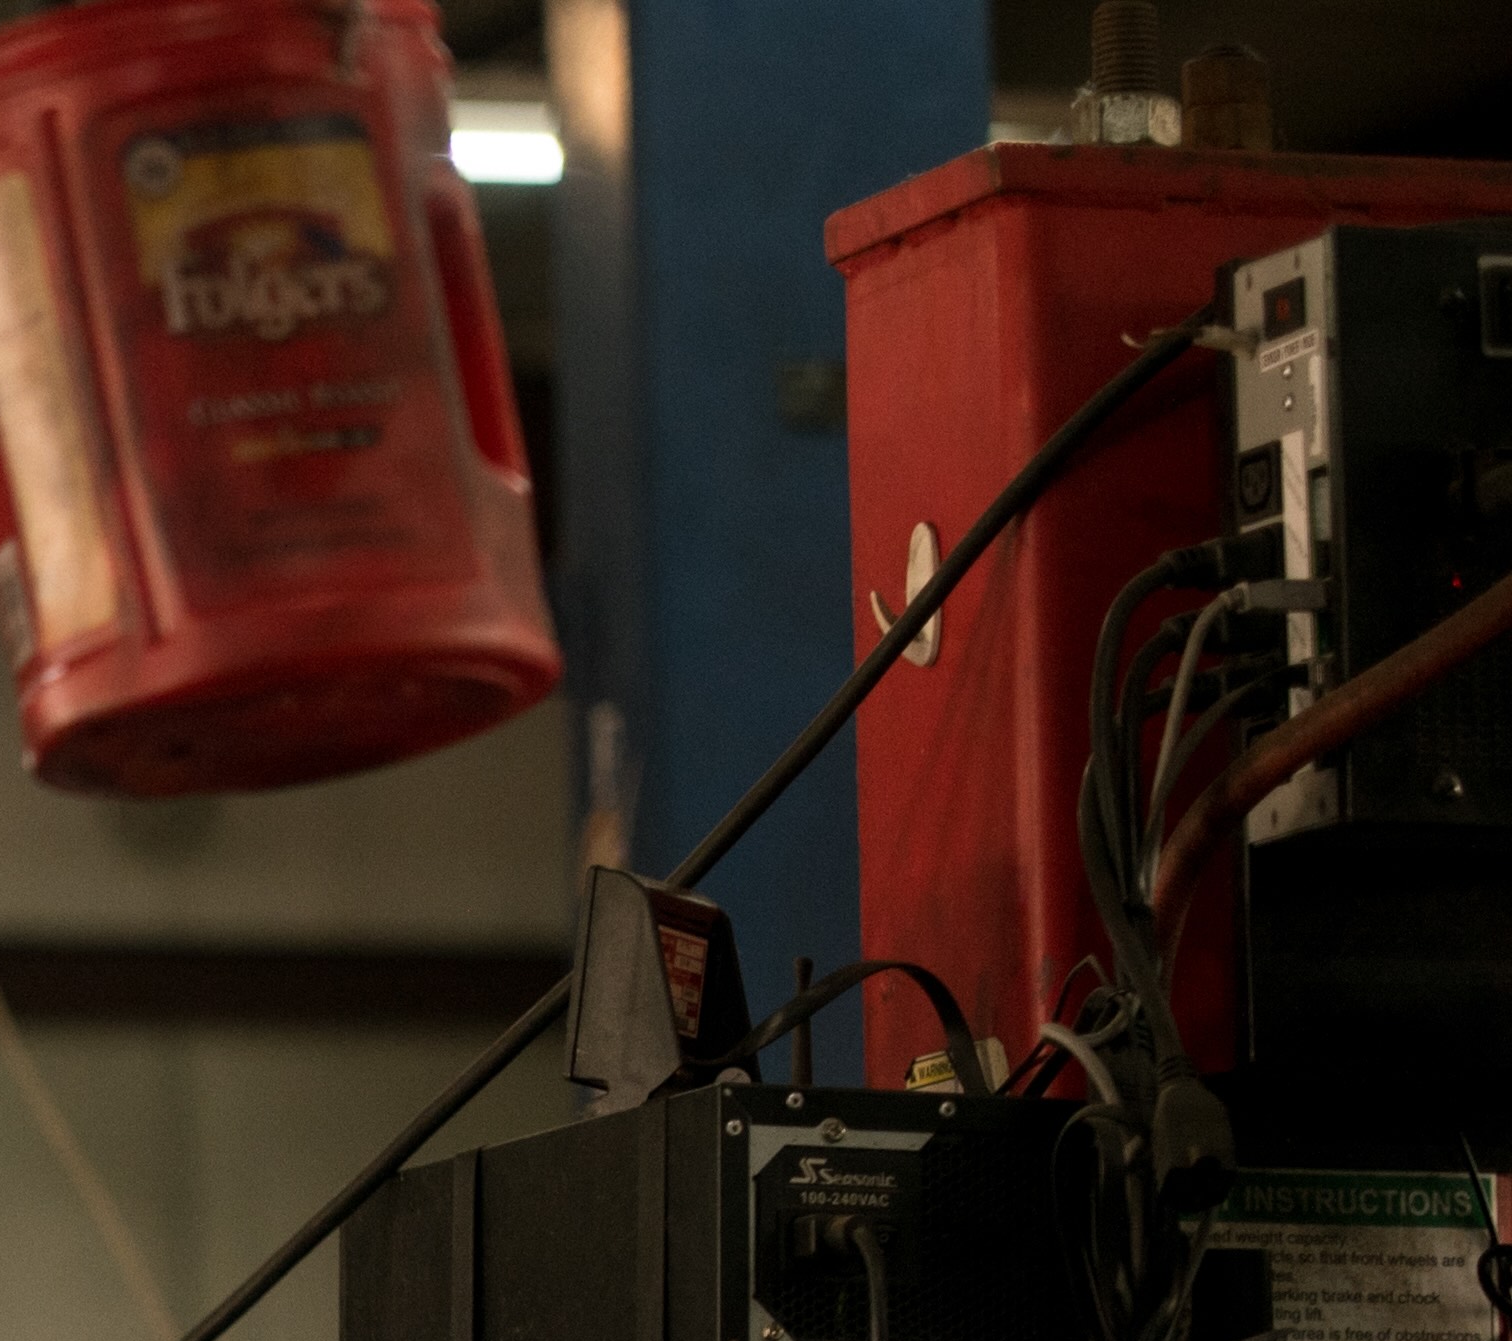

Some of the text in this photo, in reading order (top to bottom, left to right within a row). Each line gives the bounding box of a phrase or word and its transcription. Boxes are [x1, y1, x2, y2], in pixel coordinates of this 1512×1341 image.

[163, 245, 389, 341] Folgers
[801, 1191, 889, 1207] 100-240VAC
[1243, 1184, 1472, 1218] INSTRUCTIONS
[1236, 1231, 1283, 1247] weight
[1320, 1250, 1348, 1264] that
[1350, 1251, 1384, 1265] front
[1387, 1252, 1437, 1266] wheels
[1441, 1256, 1465, 1266] are
[1273, 1289, 1440, 1304] arking brake and chock
[1293, 1330, 1325, 1341] area
[1329, 1328, 1342, 1341] is
[1345, 1328, 1373, 1341] free
[1377, 1328, 1392, 1341] of
